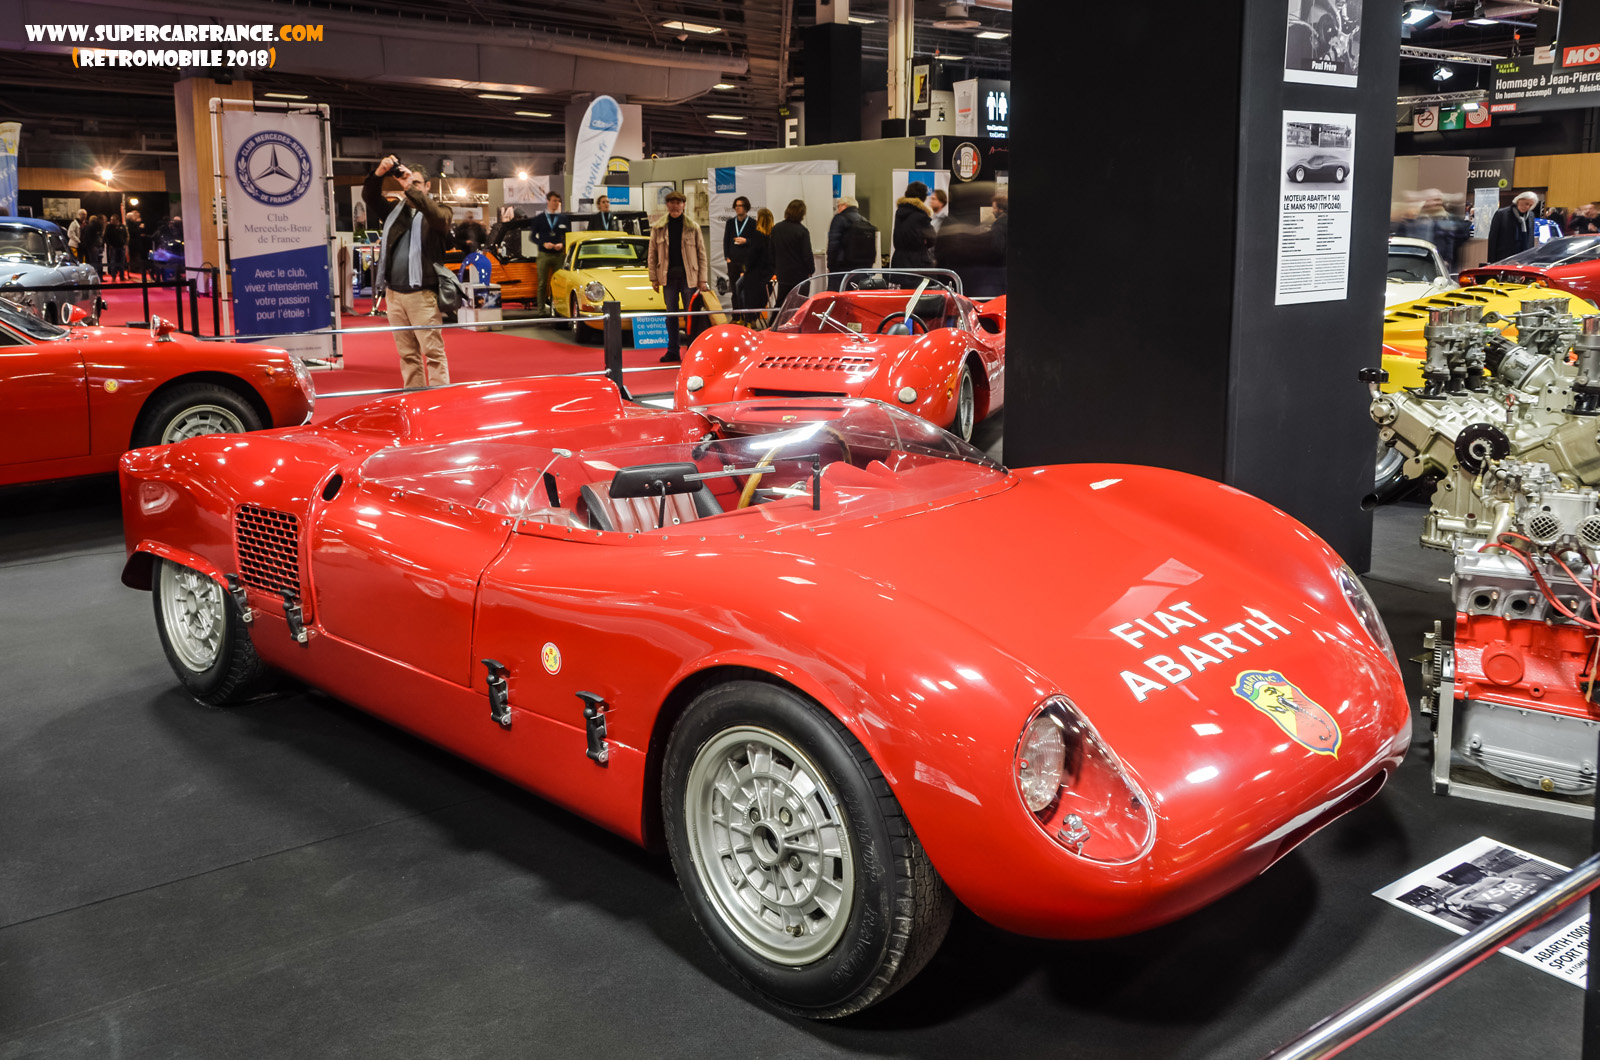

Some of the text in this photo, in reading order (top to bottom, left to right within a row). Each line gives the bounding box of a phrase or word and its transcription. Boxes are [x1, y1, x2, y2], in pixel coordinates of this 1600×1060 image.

[1565, 47, 1600, 64] MO
[1312, 60, 1323, 70] Paul
[1495, 71, 1600, 90] Hommage à Jean-Pierre
[1495, 92, 1503, 100] Un
[1504, 90, 1525, 99] homme
[1525, 88, 1552, 97] accompli
[1557, 86, 1575, 95] Pilote
[1491, 104, 1516, 112] MOTUL
[785, 118, 798, 148] E
[241, 133, 307, 158] CLUB MERCEDES-BENZ
[260, 194, 293, 203] DE FRANCE
[1307, 194, 1327, 202] ABARTH
[267, 213, 289, 222] Club
[244, 224, 312, 233] Mercedes-Benz
[271, 235, 300, 243] France
[255, 267, 307, 278] Avec le club,
[244, 281, 318, 292] vivez intensément
[255, 296, 310, 306] votre passion
[256, 311, 275, 321] pour
[1109, 601, 1209, 649] FIAT
[1119, 614, 1292, 702] ABARTH
[1243, 675, 1265, 695] ABARTH
[1481, 882, 1522, 900] 158
[1534, 938, 1572, 962] ABARTH
[1549, 948, 1583, 969] SPORT
